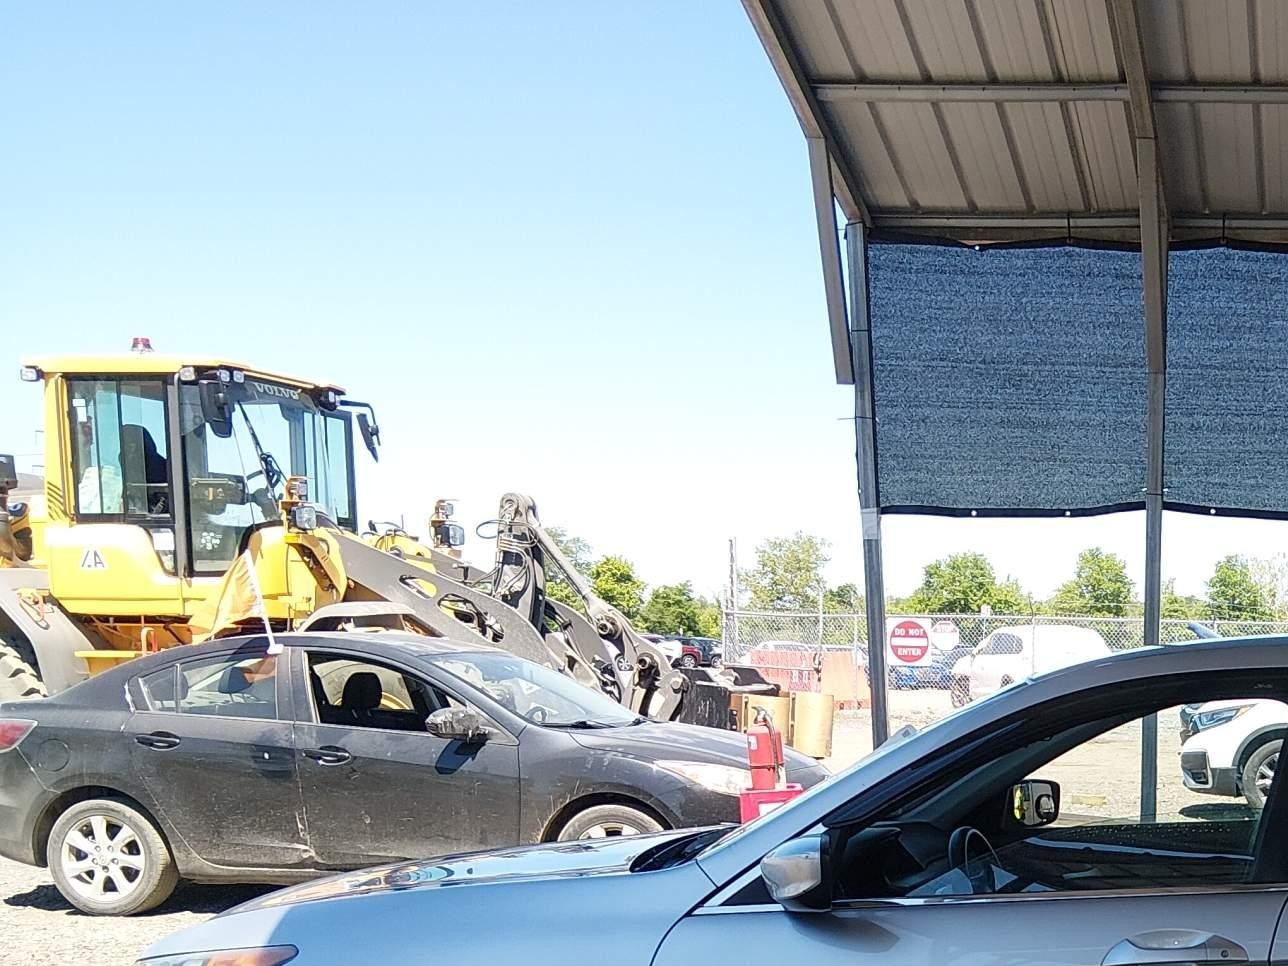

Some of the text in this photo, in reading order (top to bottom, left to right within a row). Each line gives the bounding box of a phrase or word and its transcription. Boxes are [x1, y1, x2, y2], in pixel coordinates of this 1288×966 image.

[253, 382, 300, 400] VOLVO
[894, 628, 924, 636] DO NOT
[897, 647, 922, 656] ENTER
